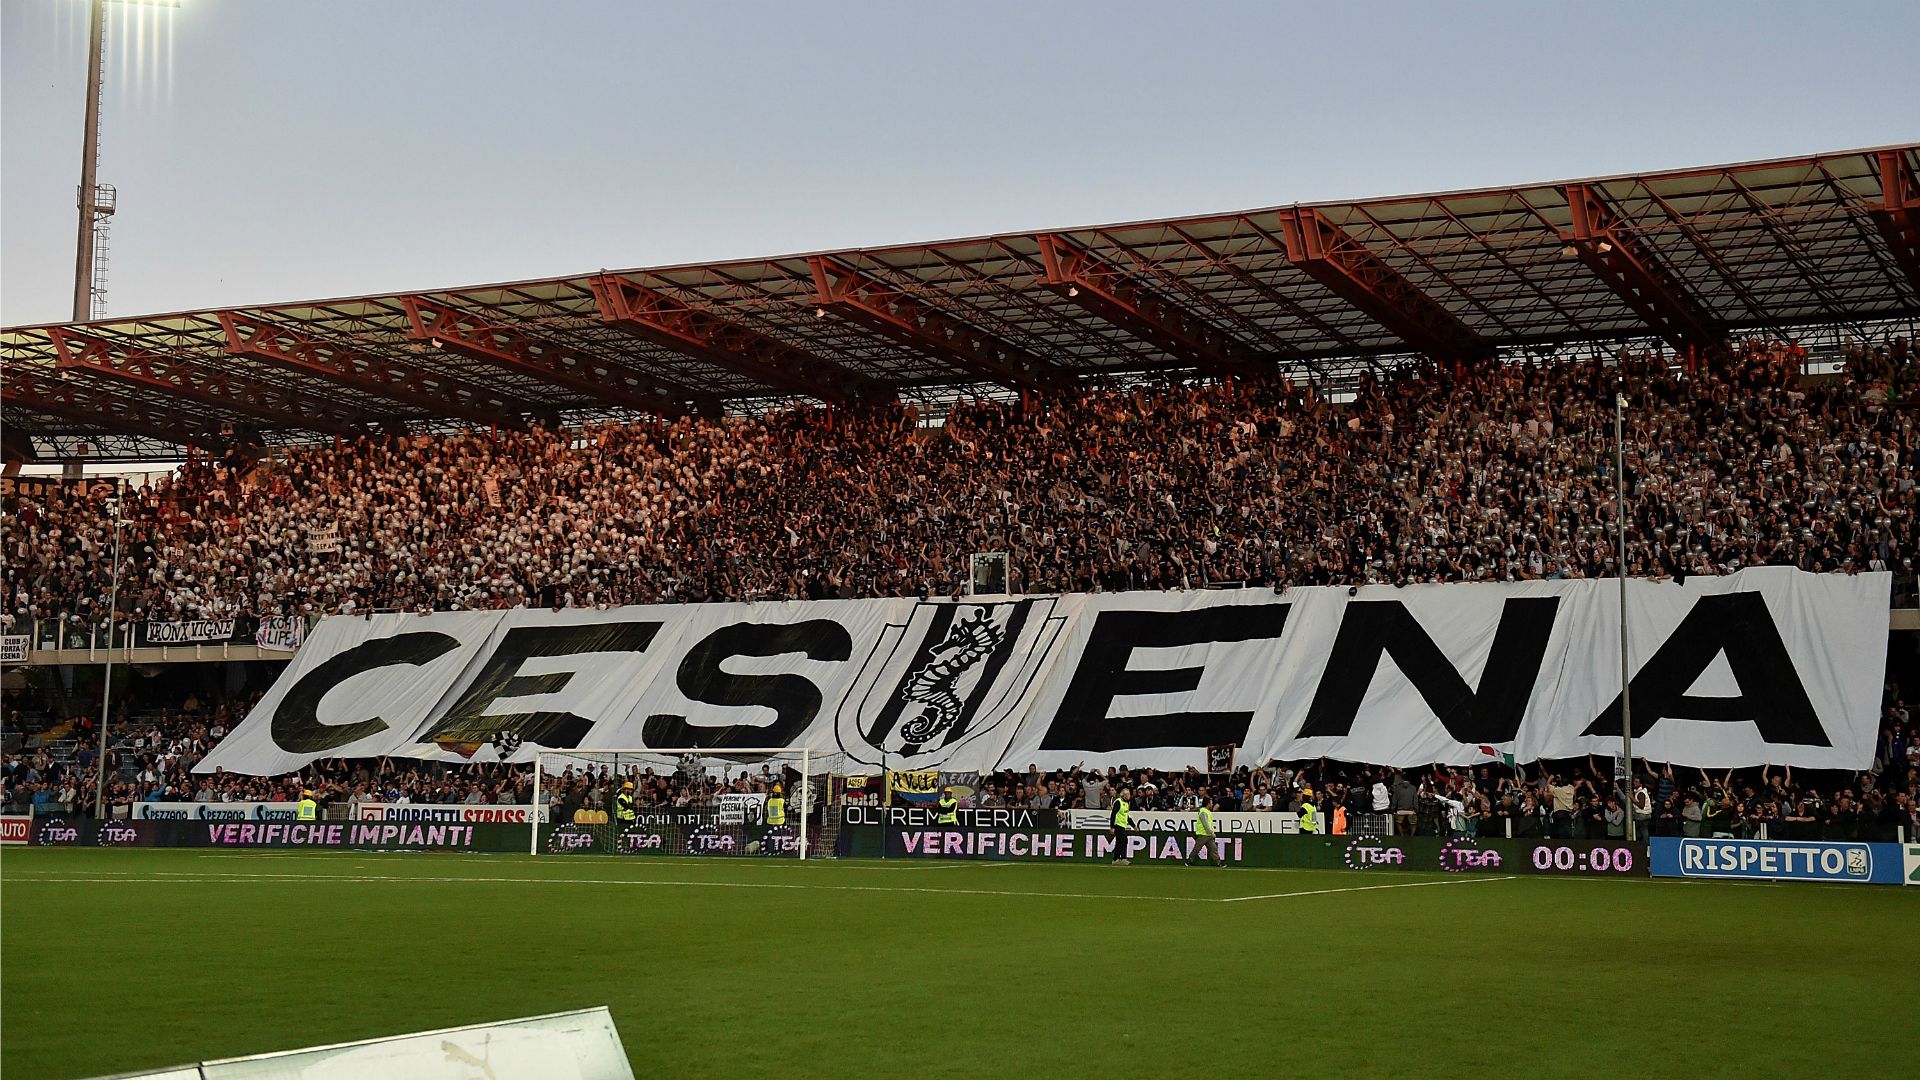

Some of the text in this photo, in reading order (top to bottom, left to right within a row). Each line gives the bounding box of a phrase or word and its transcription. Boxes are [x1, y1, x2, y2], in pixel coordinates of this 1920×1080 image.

[191, 619, 234, 638] VIGNE
[847, 807, 1034, 828] OLTREMTERIA
[209, 824, 474, 846] VERIFICHE IMPIANTI
[901, 831, 1243, 861] VERIFICHE IMPIANTI
[1532, 846, 1633, 872] 00:00
[1684, 843, 1845, 874] RISPETTO
